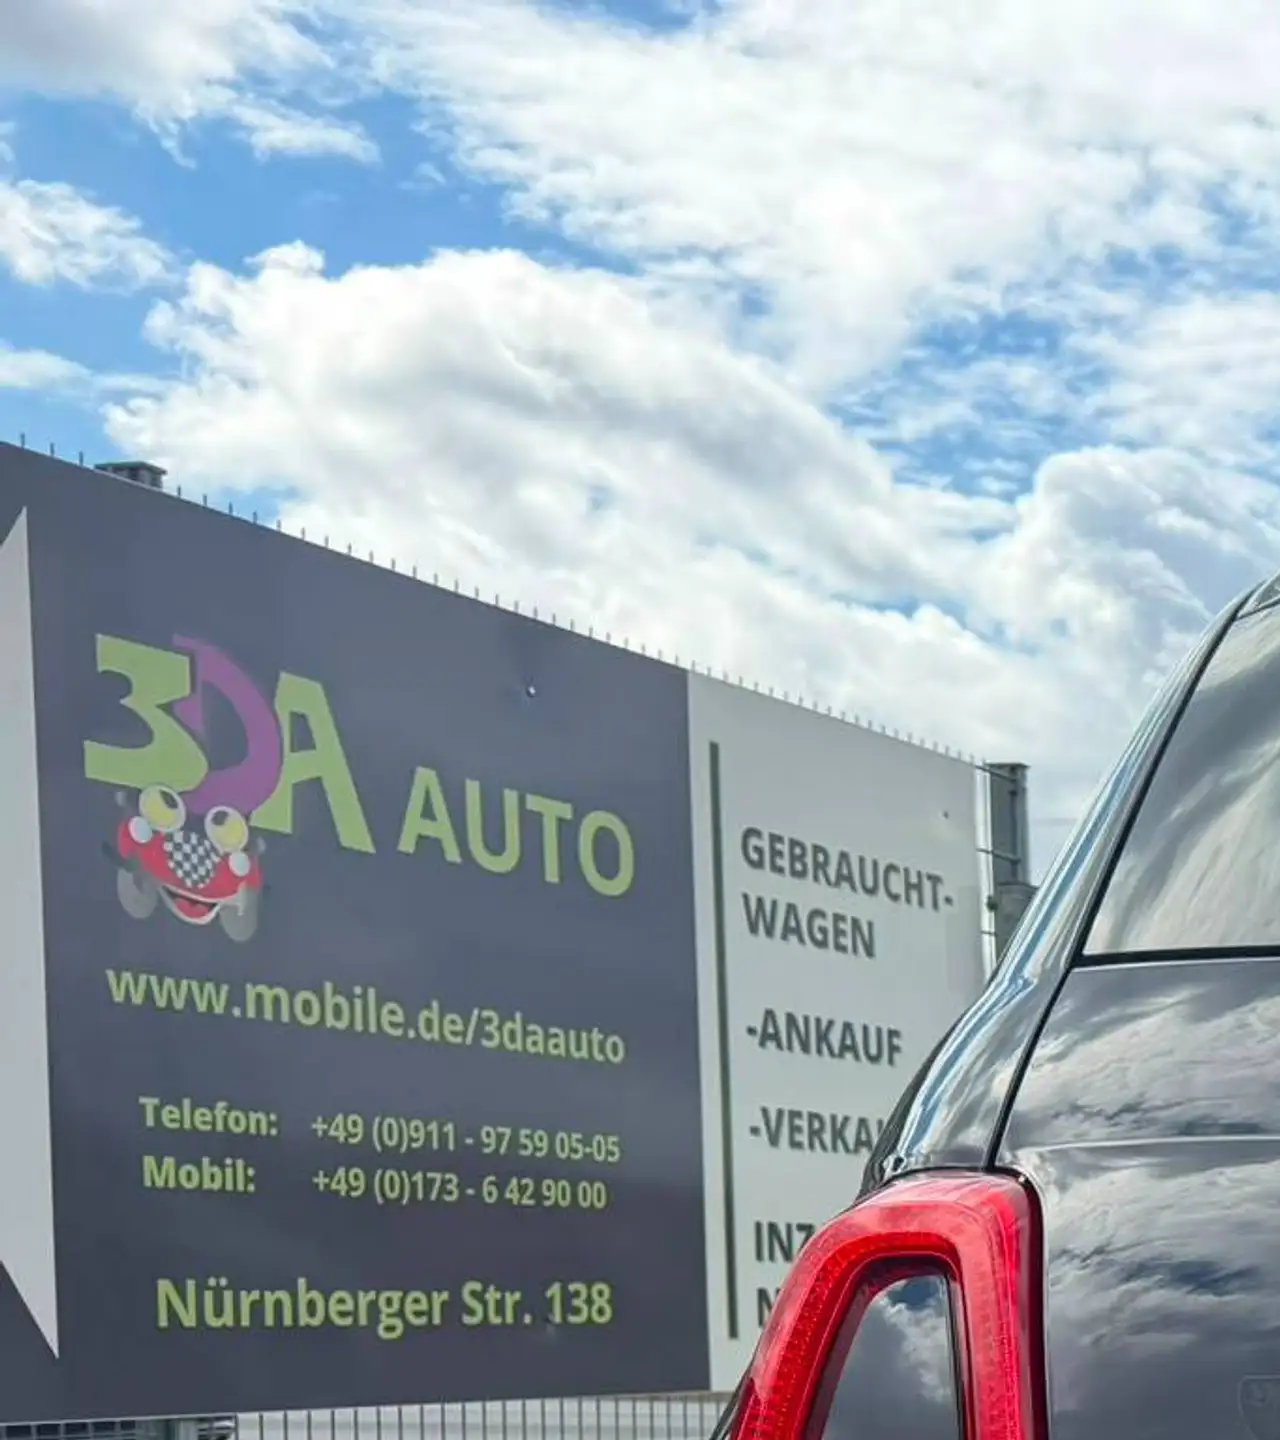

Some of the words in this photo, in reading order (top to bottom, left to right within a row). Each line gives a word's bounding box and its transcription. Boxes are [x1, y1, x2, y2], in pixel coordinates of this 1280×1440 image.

[84, 633, 376, 854] 3DA
[397, 766, 635, 896] AUTO
[740, 827, 953, 911] GEBRAUCHT-
[741, 892, 875, 958] WAGEN
[105, 968, 626, 1064] www.mobile.de/3daauto
[746, 1008, 902, 1067] -ANKAUF
[139, 1096, 278, 1136] Telefon:
[311, 1113, 364, 1144] +49
[372, 1116, 455, 1153] (0)911
[480, 1125, 512, 1155] 97
[519, 1128, 549, 1158] 59
[555, 1131, 620, 1163] 05-05
[749, 1106, 882, 1155] -VERKA
[143, 1155, 255, 1193] Mobil:
[312, 1166, 366, 1197] +49
[374, 1168, 459, 1205] (0)173
[482, 1175, 498, 1204] 6
[504, 1177, 536, 1206] 42
[542, 1178, 571, 1208] 90
[577, 1180, 607, 1209] 00
[156, 1278, 448, 1339] Nürnberger
[461, 1281, 532, 1326] Str.
[544, 1282, 613, 1326] 138
